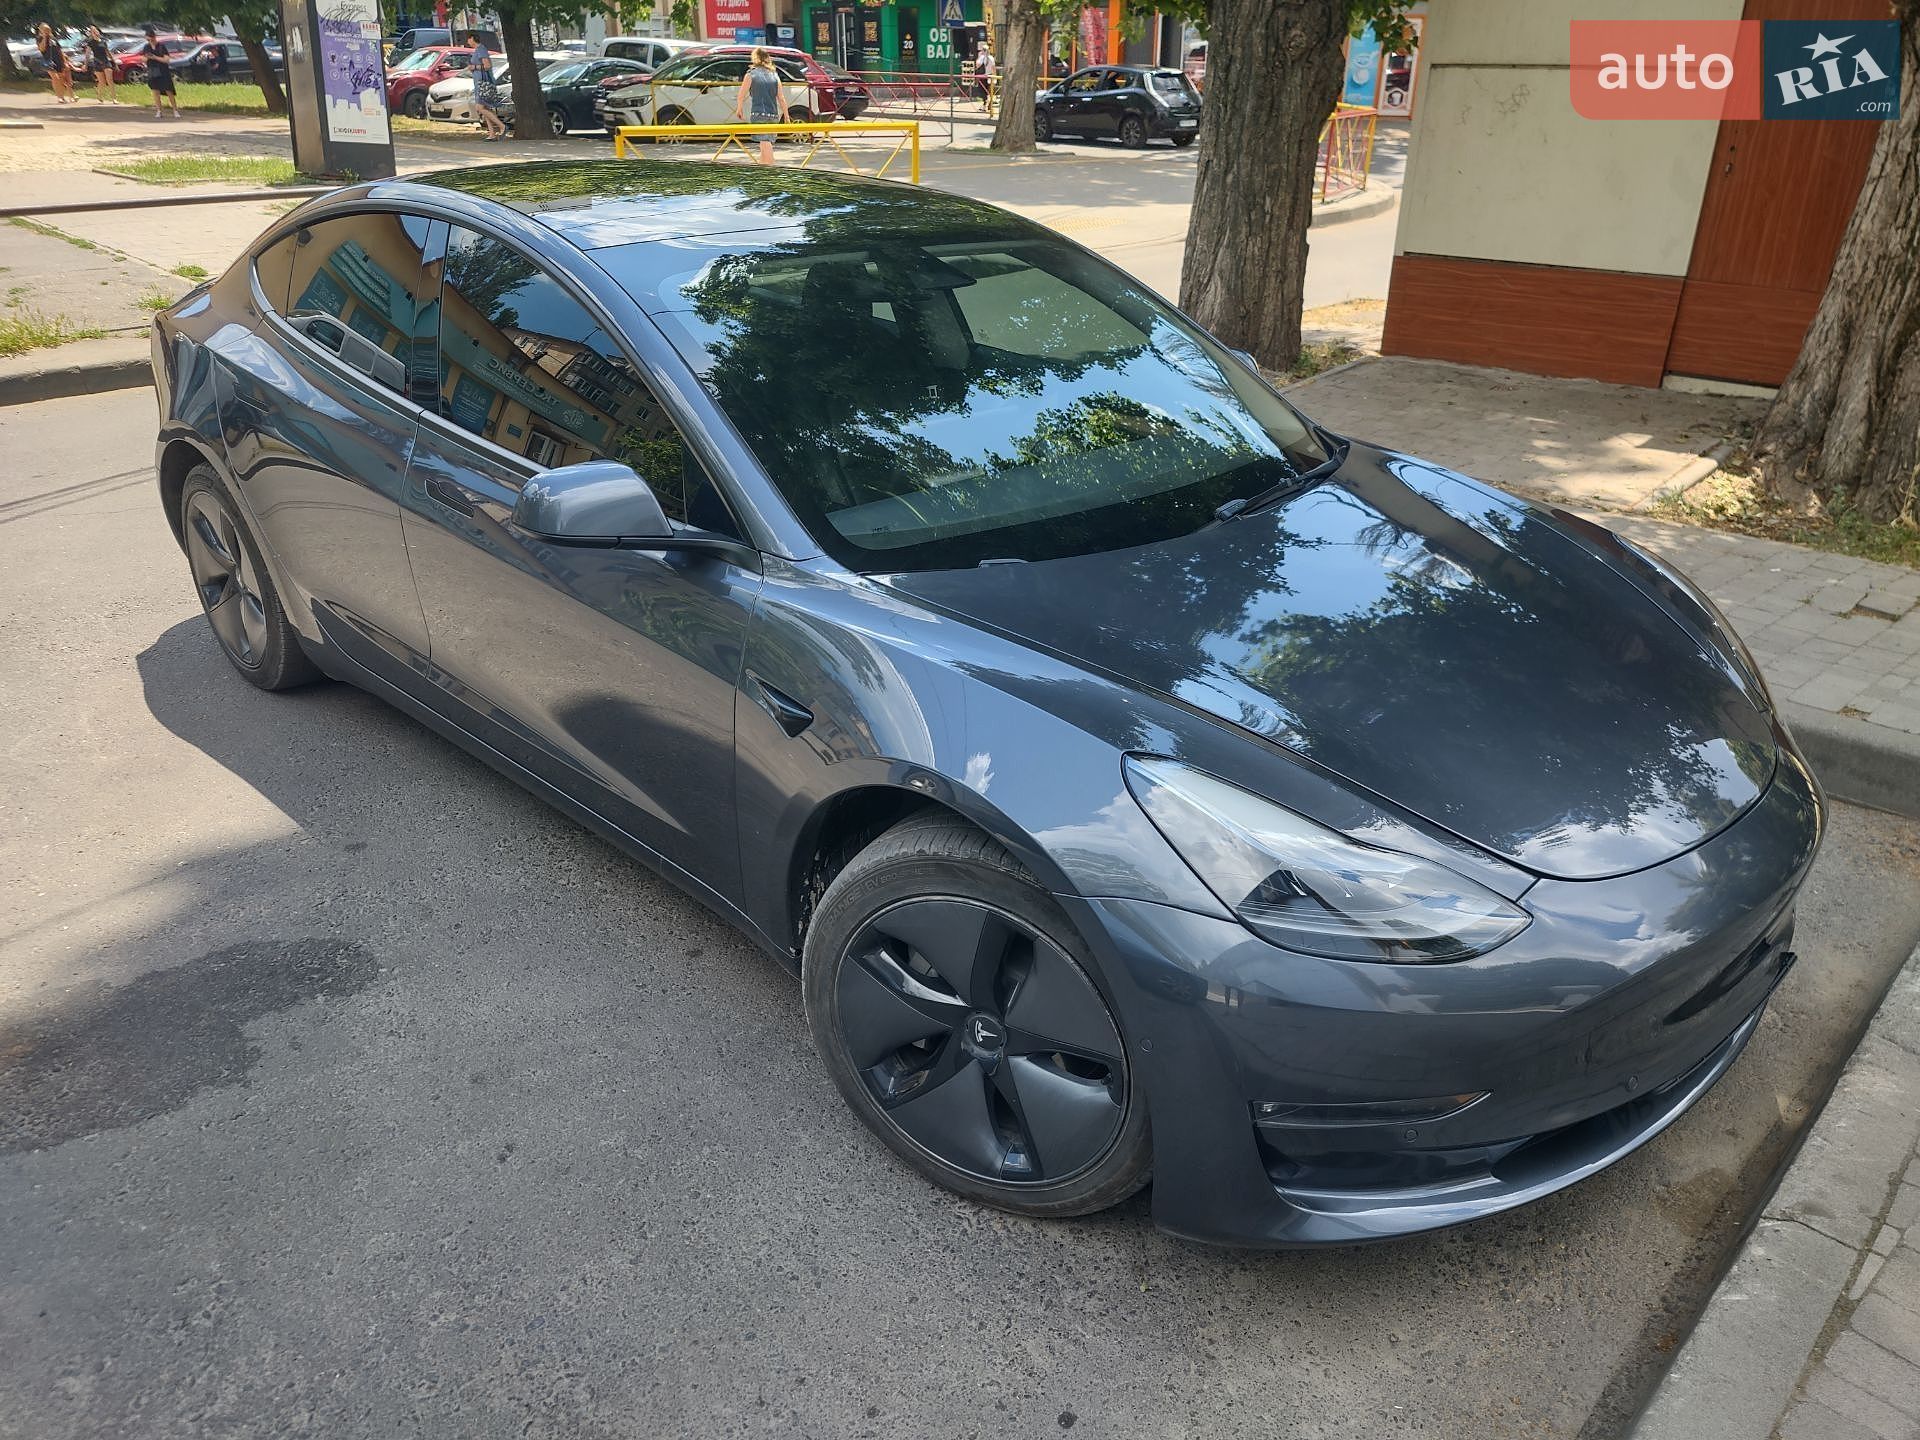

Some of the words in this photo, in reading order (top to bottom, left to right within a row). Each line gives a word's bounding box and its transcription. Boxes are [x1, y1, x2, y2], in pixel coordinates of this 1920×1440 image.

[717, 27, 736, 36] ПРОГ
[903, 40, 915, 49] 20
[926, 44, 951, 59] ВАЛ
